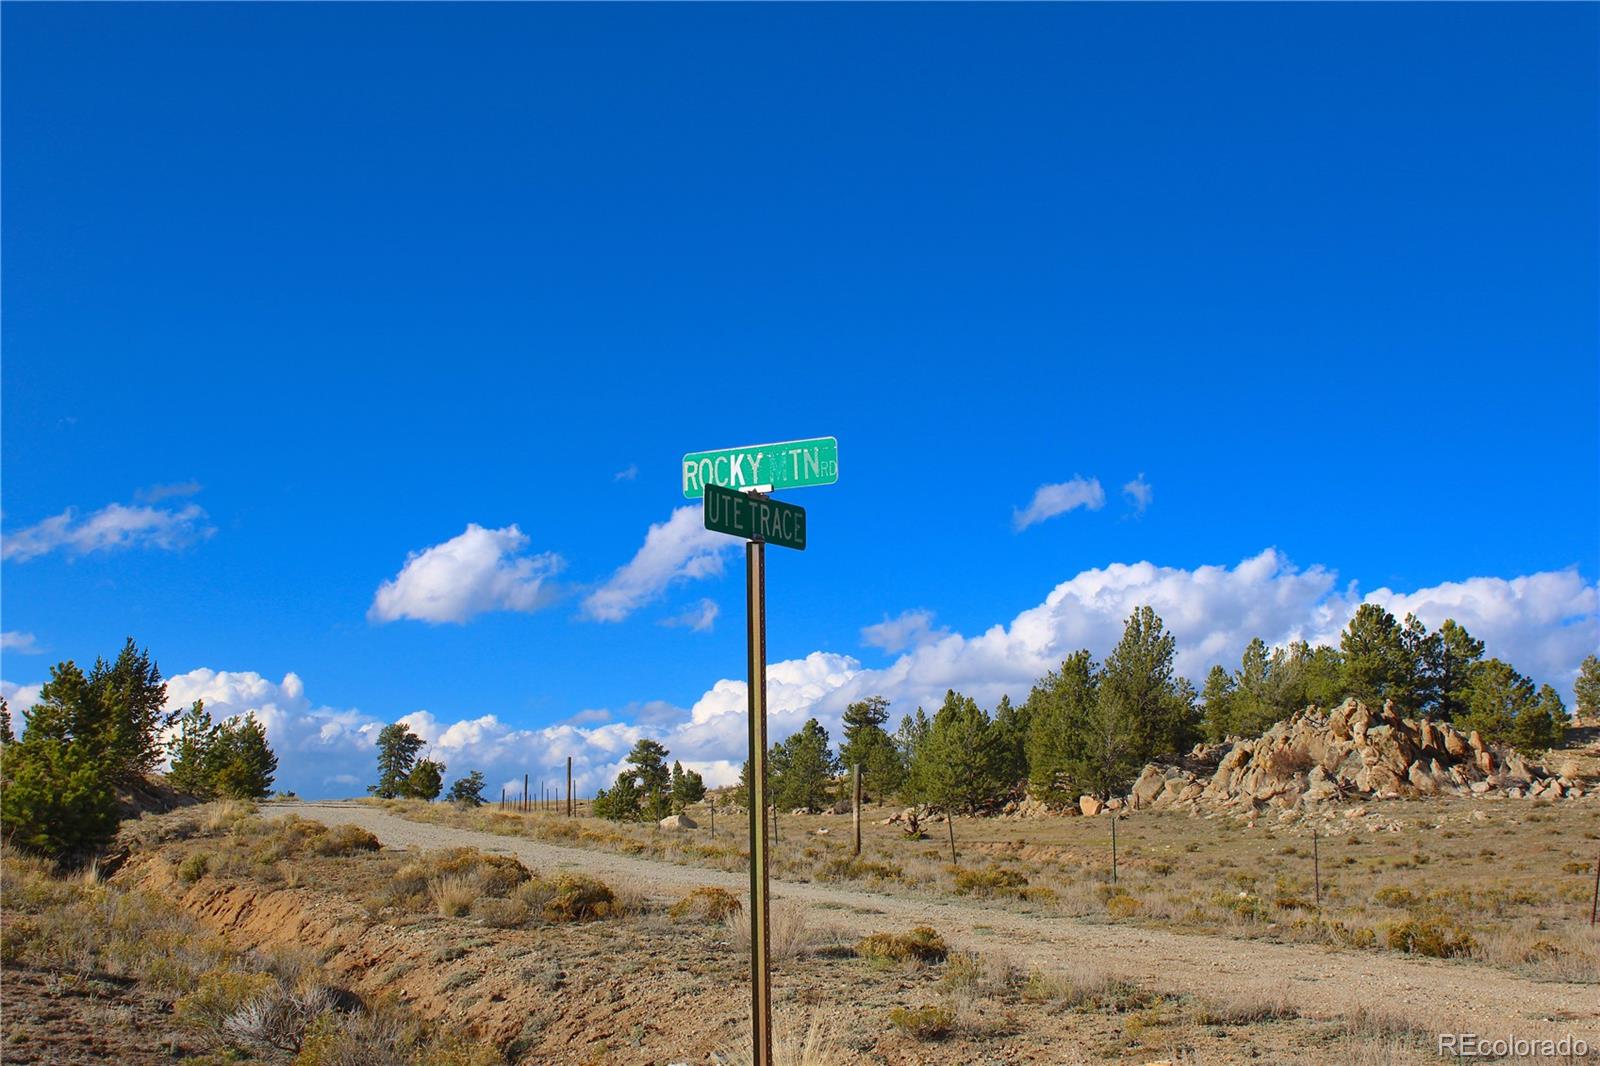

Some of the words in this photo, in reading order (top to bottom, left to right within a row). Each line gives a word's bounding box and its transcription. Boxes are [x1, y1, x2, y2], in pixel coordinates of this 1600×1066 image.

[683, 452, 763, 491] ROCKY
[821, 460, 837, 477] RD
[708, 491, 743, 530] UTE
[749, 502, 804, 543] TRACE
